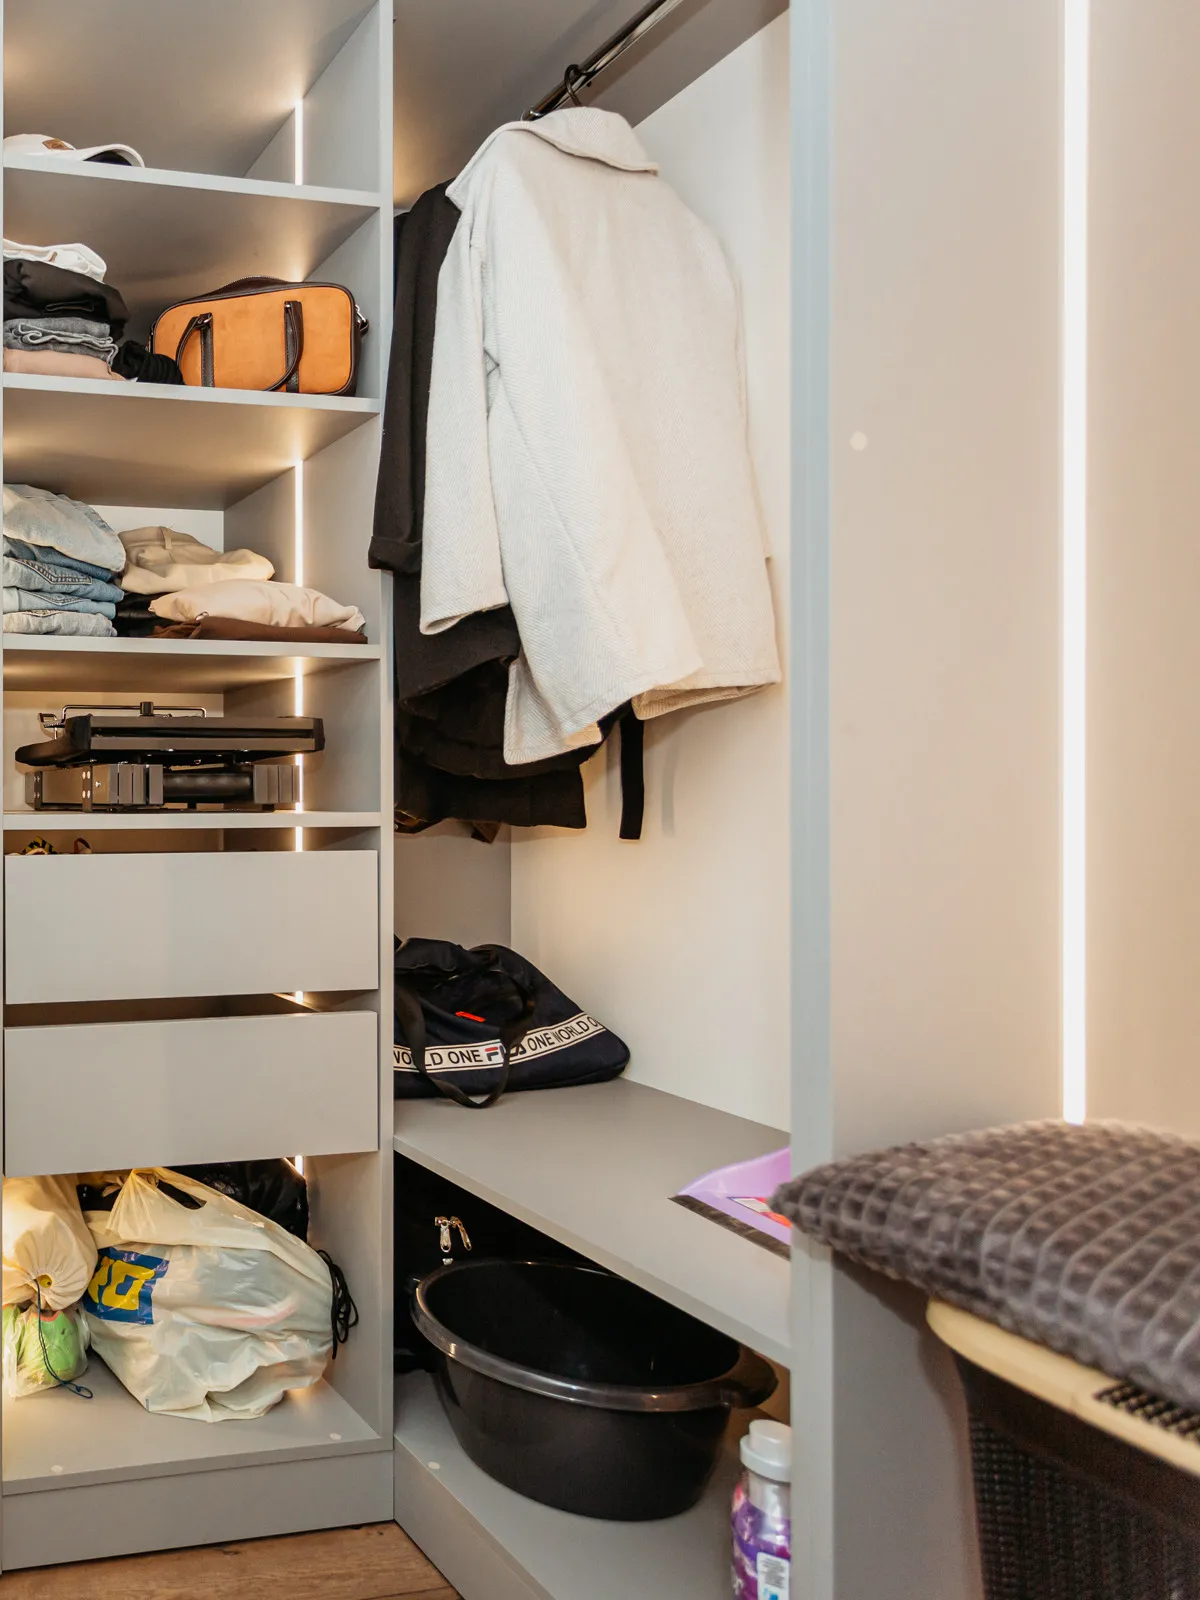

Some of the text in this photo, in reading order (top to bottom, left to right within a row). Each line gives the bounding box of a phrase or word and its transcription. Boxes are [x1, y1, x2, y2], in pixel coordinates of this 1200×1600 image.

[447, 1049, 484, 1065] ONE
[527, 1032, 556, 1052] ONE
[552, 1020, 590, 1043] WORLD
